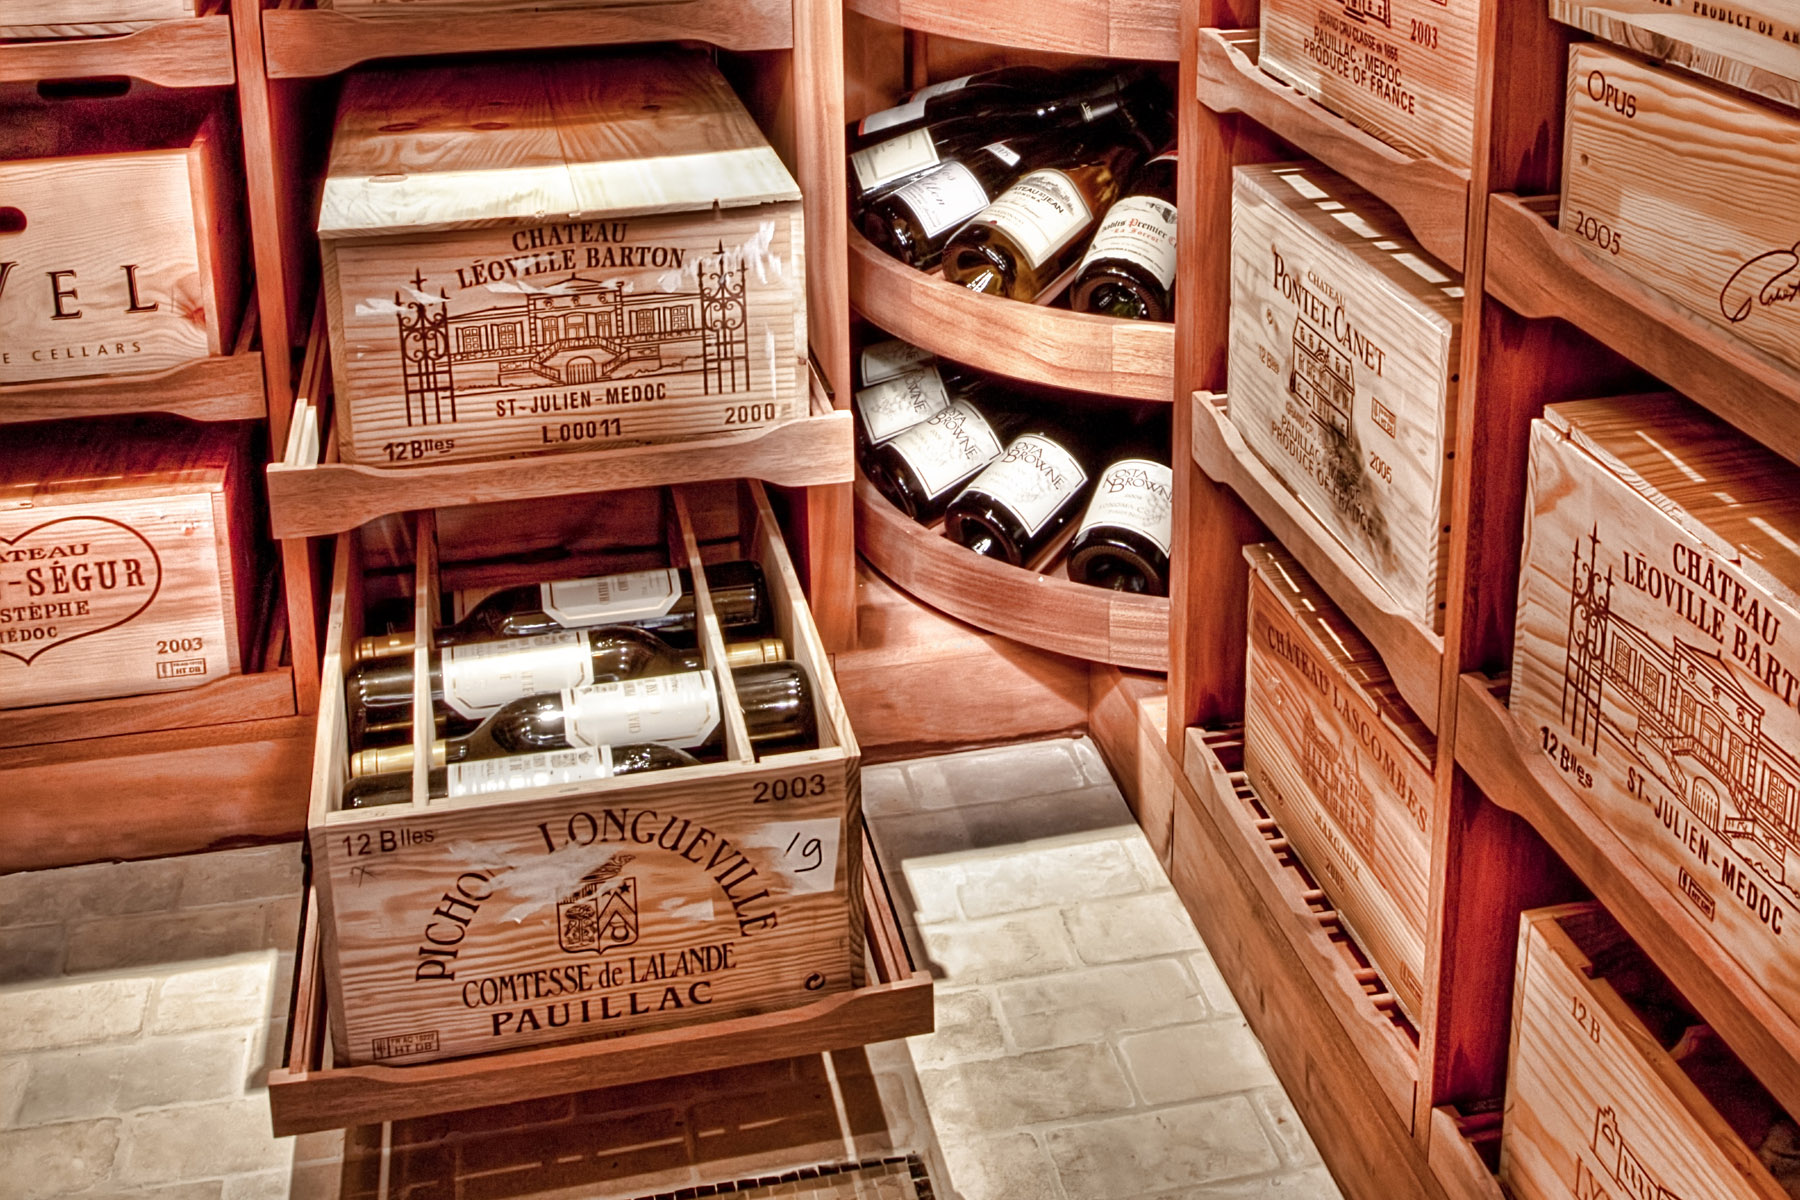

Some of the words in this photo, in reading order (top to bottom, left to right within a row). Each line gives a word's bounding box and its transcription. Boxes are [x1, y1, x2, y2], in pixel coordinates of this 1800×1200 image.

[1314, 25, 1356, 61] PAUILLAC
[1365, 54, 1402, 87] MEDOC
[1410, 18, 1438, 49] 2003
[1303, 38, 1349, 79] PRODUCE
[1353, 66, 1367, 87] OF
[1370, 75, 1415, 115] FRANCE
[1575, 211, 1622, 255] 2005
[586, 246, 687, 269] BARTON
[31, 341, 141, 362] CELLARS
[724, 402, 776, 426] 2000
[1001, 449, 1065, 490] BROWNE
[1272, 420, 1314, 477] PRODUCE
[1370, 451, 1392, 484] 2005
[1108, 477, 1172, 503] BROWN
[1673, 543, 1781, 646] CHÂTEAU
[156, 637, 203, 654] 2003
[1623, 550, 1725, 644] LÉOVILLE
[1732, 623, 1800, 712] BART
[1333, 685, 1428, 834] LASCOMBES
[753, 773, 826, 804] 2003
[342, 833, 372, 857] 12
[1314, 810, 1360, 881] MARGAUX
[415, 867, 500, 982] PICHO
[538, 808, 778, 937] LONGUEVILLE
[463, 964, 593, 1009] COMTESSE
[599, 961, 623, 989] de
[629, 942, 737, 984] LALANDE
[492, 981, 713, 1036] PAUILLAC
[1572, 997, 1588, 1031] 12
[1590, 1020, 1600, 1044] B
